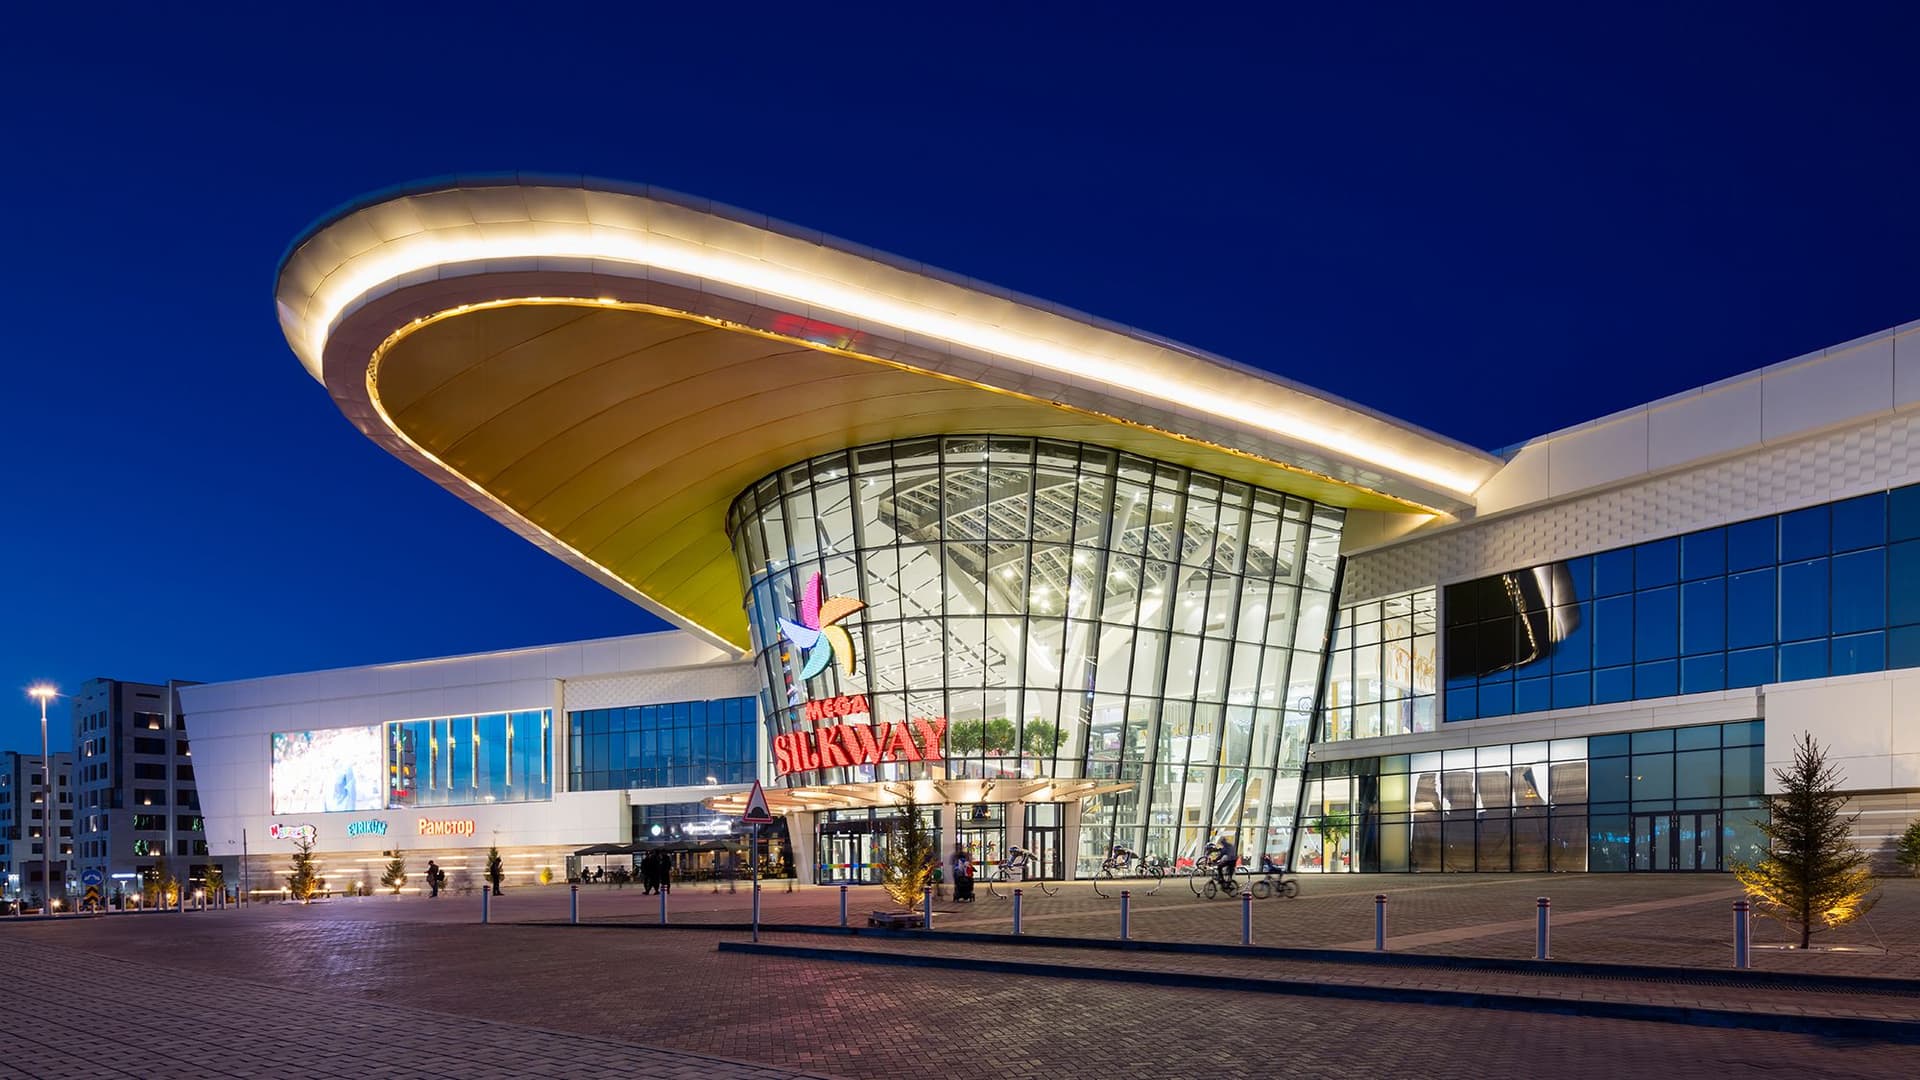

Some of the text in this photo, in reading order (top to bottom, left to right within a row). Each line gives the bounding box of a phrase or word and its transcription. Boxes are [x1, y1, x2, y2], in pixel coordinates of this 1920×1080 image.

[805, 694, 869, 721] MEGA
[774, 716, 947, 775] SILKWAY
[419, 818, 474, 837] Рамстор
